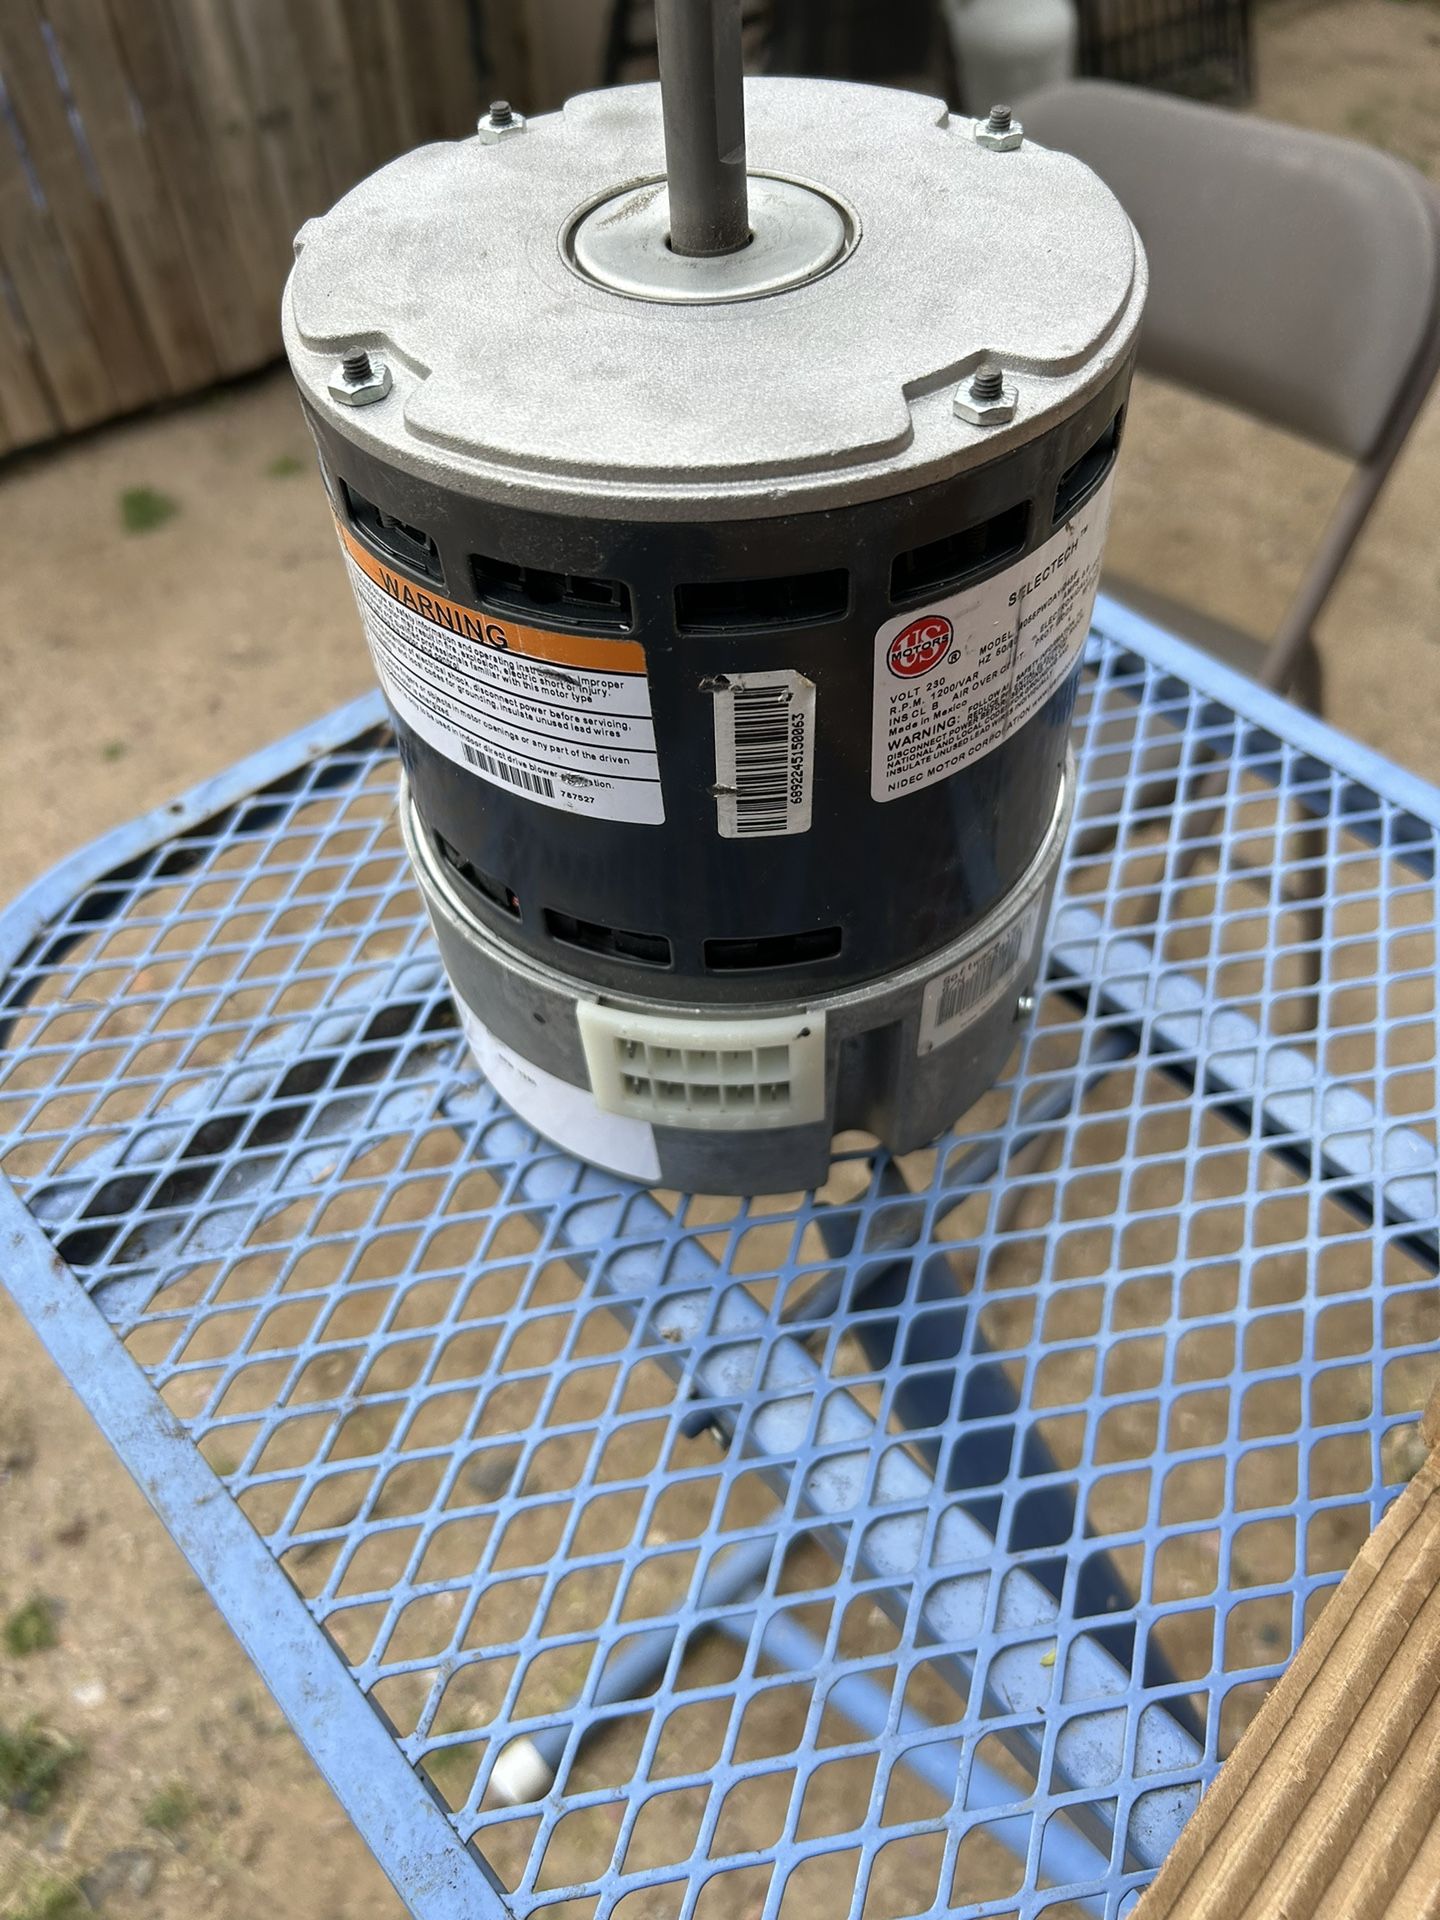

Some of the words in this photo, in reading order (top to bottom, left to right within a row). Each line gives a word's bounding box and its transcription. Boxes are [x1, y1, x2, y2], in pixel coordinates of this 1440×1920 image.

[1008, 538, 1079, 607] SELECTECH
[379, 567, 509, 650] WARNING
[457, 641, 473, 654] and
[474, 648, 516, 671] operating
[577, 675, 625, 690] Improper
[891, 633, 949, 663] MOTORS
[978, 654, 992, 668] HZ
[979, 631, 1014, 656] MODEL
[460, 650, 503, 675] explosion,
[503, 665, 538, 684] electric
[539, 677, 566, 690] short
[566, 682, 577, 692] or
[578, 684, 612, 698] injury.
[469, 661, 501, 681] familiar
[502, 675, 521, 688] with
[523, 680, 540, 692] this
[541, 687, 569, 700] motor
[571, 691, 593, 704] type
[890, 686, 921, 704] VOLT
[926, 677, 946, 692] 230
[890, 698, 925, 716] R.P.M.
[930, 671, 979, 700] 1200/VAR
[447, 671, 472, 690] shock,
[473, 684, 519, 708] disconnect
[519, 702, 548, 716] power
[549, 709, 580, 723] before
[582, 715, 631, 732] servicing,
[457, 685, 499, 710] grounding,
[499, 702, 534, 721] insulate
[535, 715, 569, 730] unused
[570, 723, 592, 735] lead
[592, 727, 621, 738] wires
[887, 715, 961, 751] WARNING:
[968, 689, 1001, 714] FOLLOW
[888, 721, 918, 737] Made
[920, 716, 930, 726] in
[933, 700, 968, 721] Mexico
[889, 713, 909, 728] INS
[911, 708, 926, 720] CL
[931, 701, 939, 712] B
[952, 687, 969, 703] AIR
[972, 670, 998, 691] OVER
[459, 731, 482, 748] indoor
[483, 744, 507, 761] direct
[507, 755, 528, 769] drive
[528, 762, 558, 778] blower
[460, 709, 482, 724] motor
[483, 720, 520, 741] openings
[521, 736, 530, 745] or
[532, 739, 548, 752] any
[549, 744, 569, 756] part
[570, 749, 580, 758] of
[581, 751, 597, 761] the
[599, 750, 630, 765] driven
[886, 755, 932, 778] INSULATE
[933, 737, 969, 759] UNUSED
[970, 725, 991, 741] LEAD
[887, 733, 947, 762] DISCONNECT
[948, 715, 979, 737] POWER
[887, 746, 934, 769] NATIONAL
[936, 737, 955, 750] AND
[956, 722, 982, 741] LOCAL
[888, 772, 924, 792] NIDEC
[927, 752, 966, 777] MOTOR
[967, 705, 1031, 757] CORPOATION
